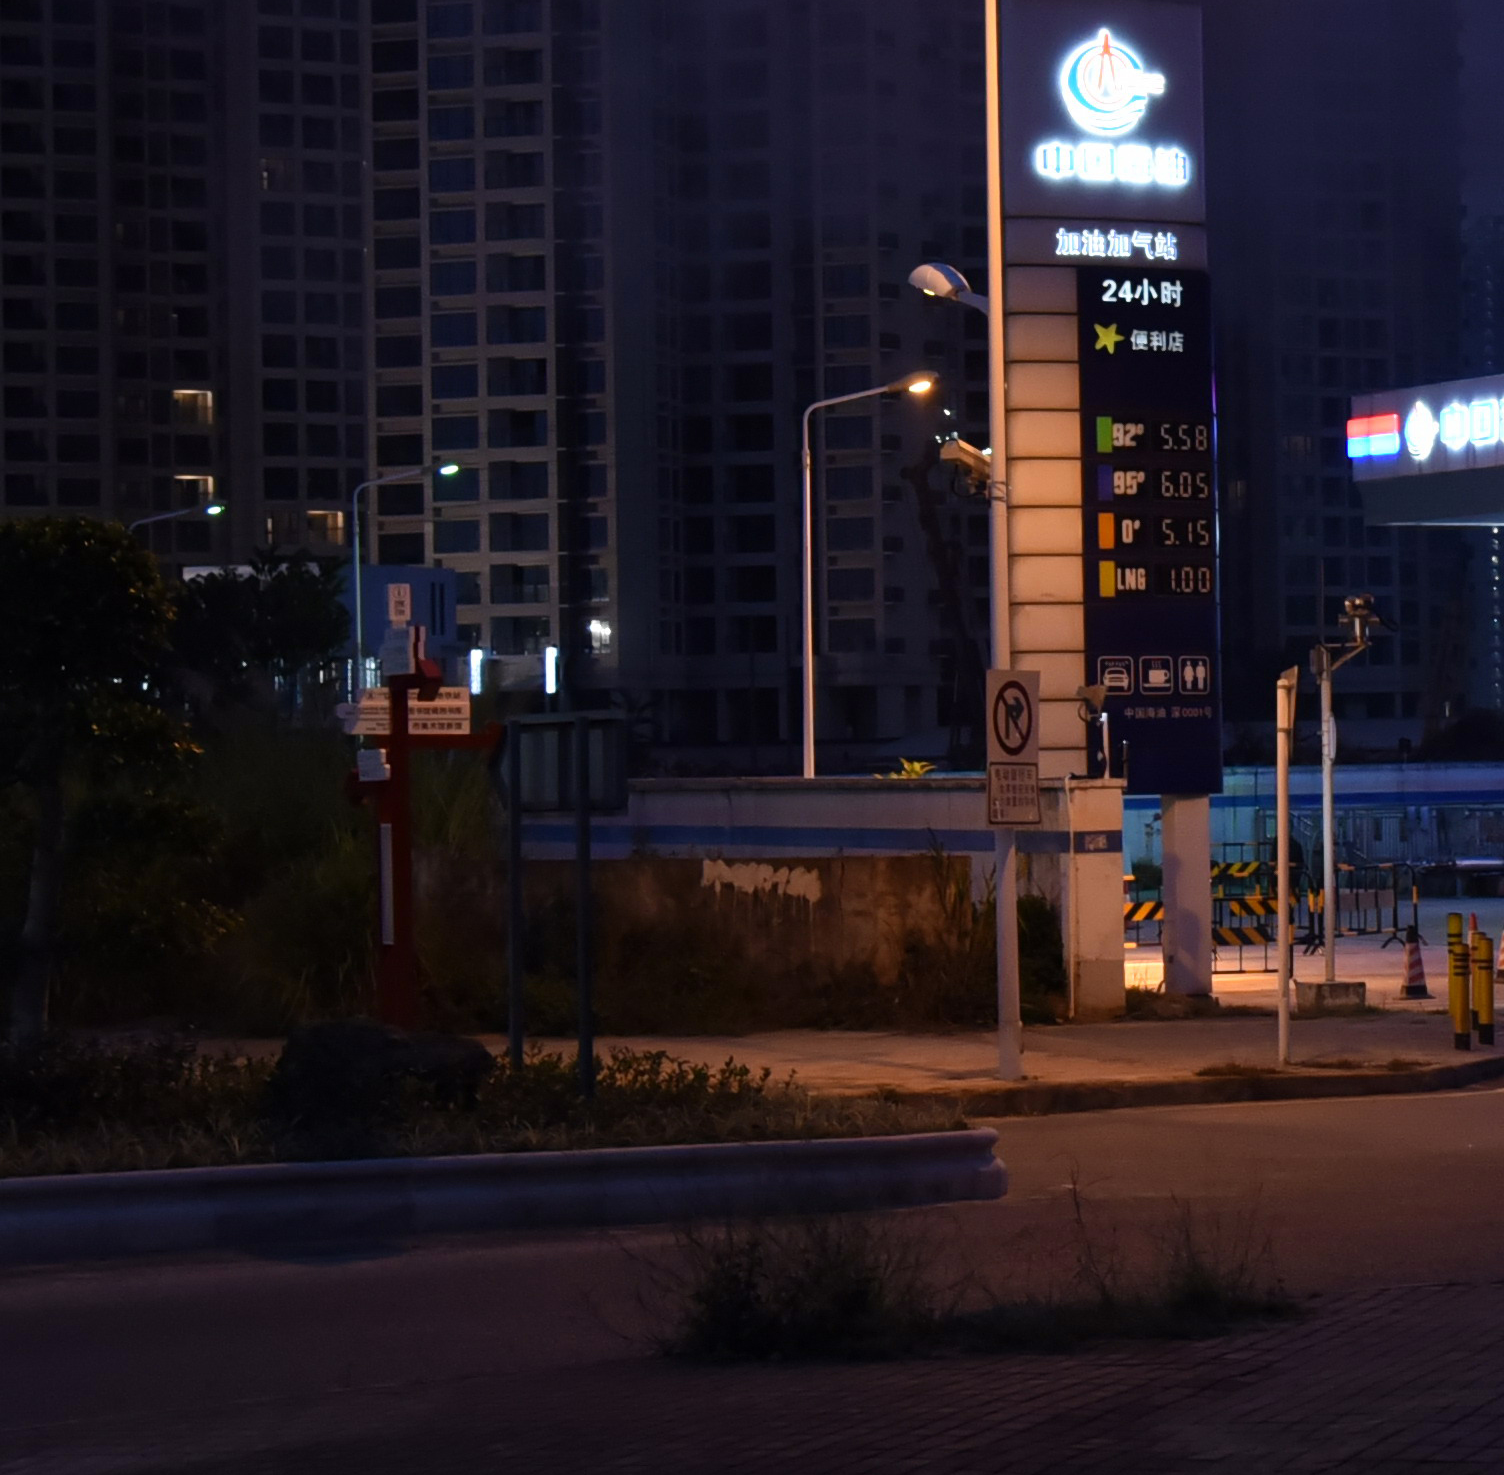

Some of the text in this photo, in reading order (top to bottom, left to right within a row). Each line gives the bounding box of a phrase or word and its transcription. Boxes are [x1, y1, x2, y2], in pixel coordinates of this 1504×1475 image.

[1056, 228, 1178, 261] 加油加气站
[1101, 277, 1184, 308] 24小时
[1129, 329, 1185, 353] 便利店
[1160, 423, 1209, 452] 5.58
[1161, 471, 1210, 499] 6.05
[1161, 518, 1210, 547] 5.15
[1116, 566, 1212, 593] LNG 1.00
